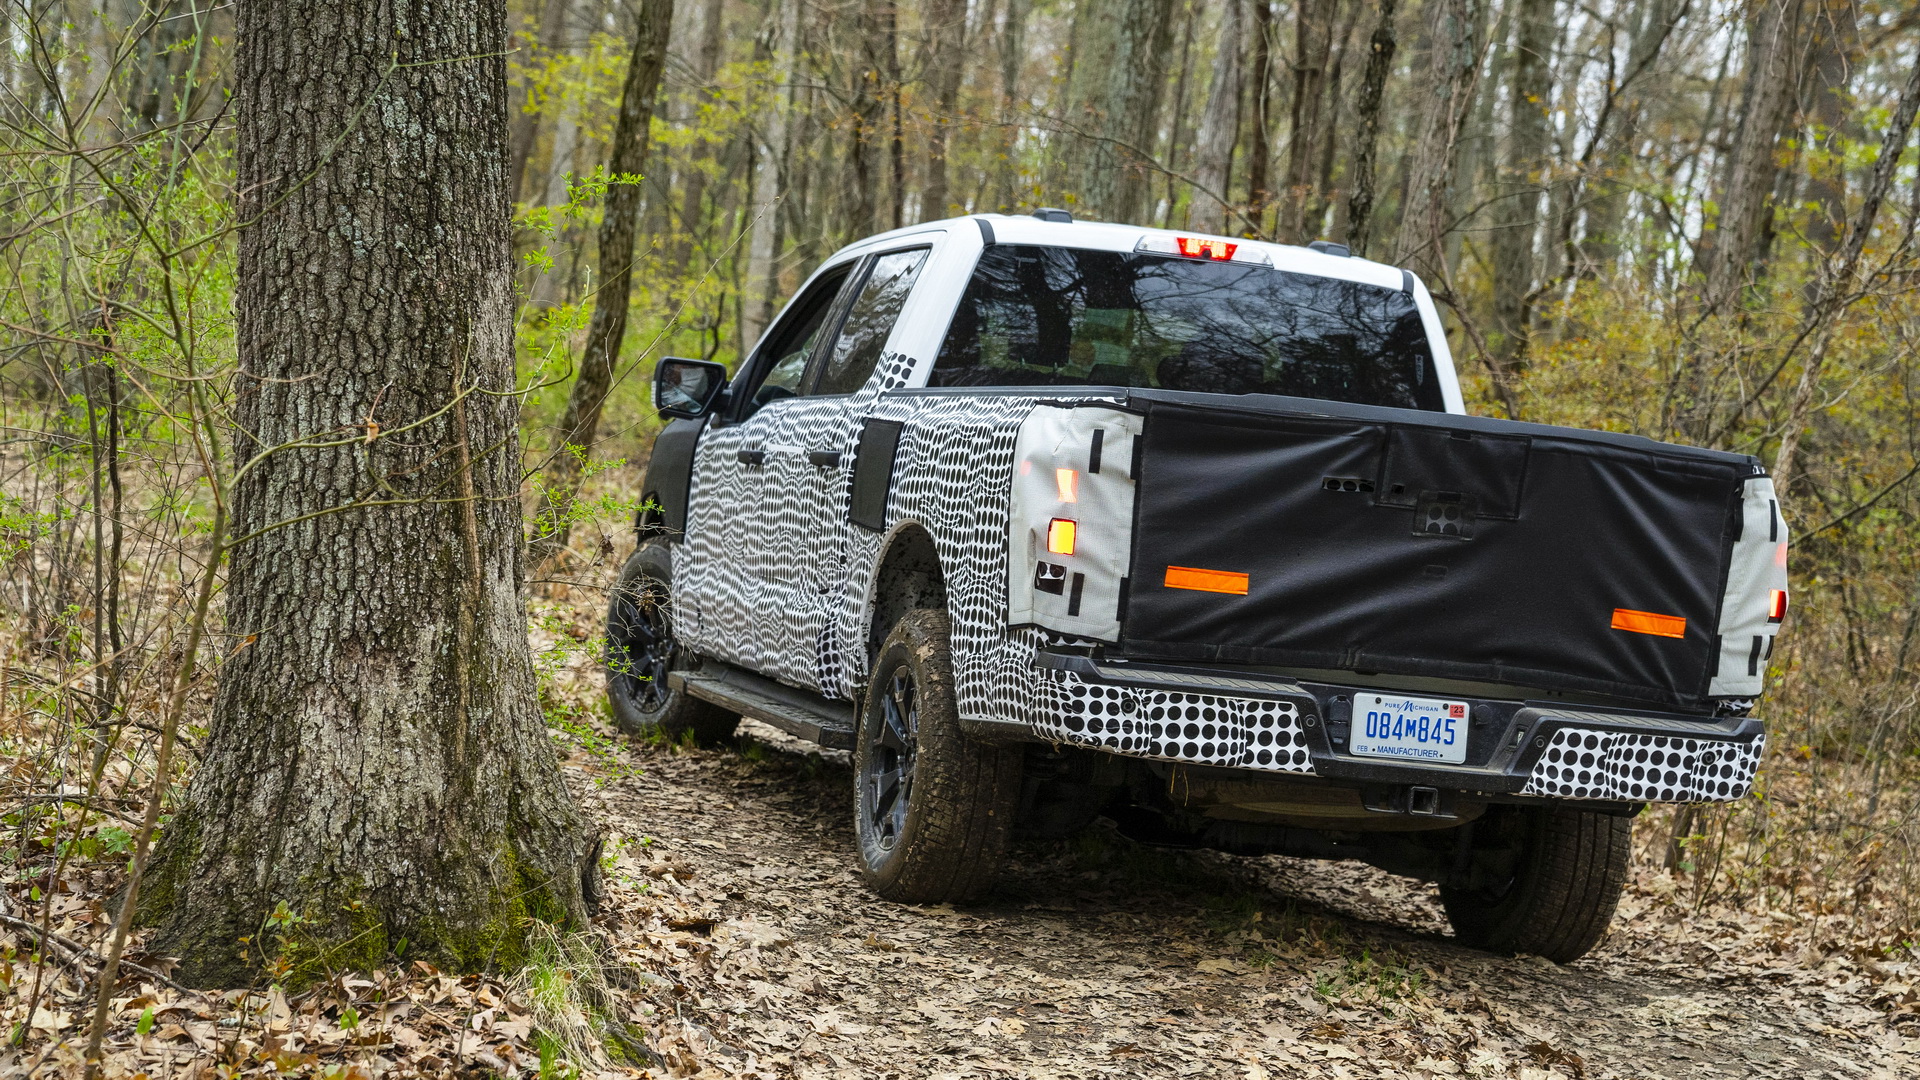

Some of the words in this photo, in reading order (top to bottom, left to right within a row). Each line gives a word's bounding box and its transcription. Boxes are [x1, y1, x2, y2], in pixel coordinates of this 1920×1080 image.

[1397, 700, 1439, 712] MICHIGAN
[1453, 706, 1464, 714] 23
[1365, 711, 1456, 745] 084M845
[1376, 745, 1439, 758] MANUFACTURER
